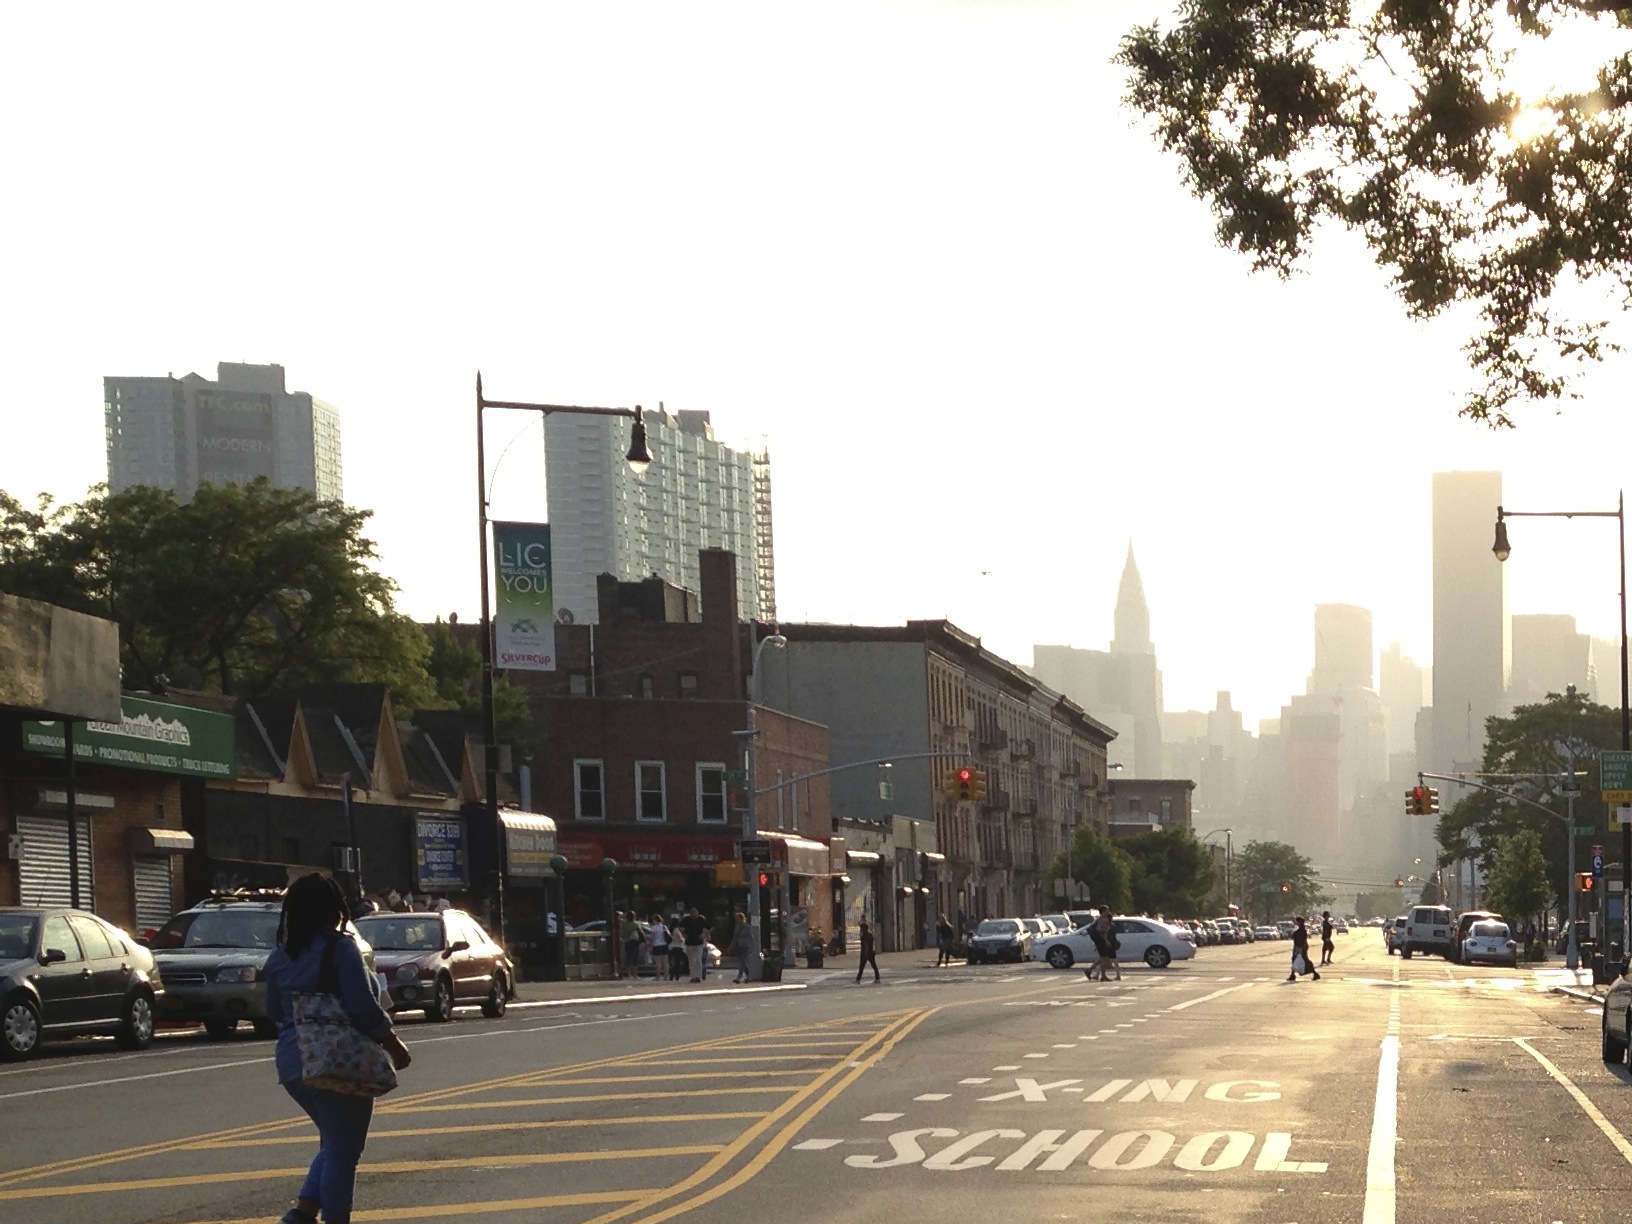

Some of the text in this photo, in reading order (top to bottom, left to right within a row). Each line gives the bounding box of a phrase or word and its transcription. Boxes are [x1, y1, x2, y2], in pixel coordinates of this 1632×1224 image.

[499, 542, 546, 568] LIC
[501, 575, 547, 594] YOU
[501, 652, 551, 666] SILVERCUP
[155, 723, 189, 745] Graphics
[977, 1078, 1282, 1102] X-ING
[844, 1127, 1329, 1173] SCHOOL
